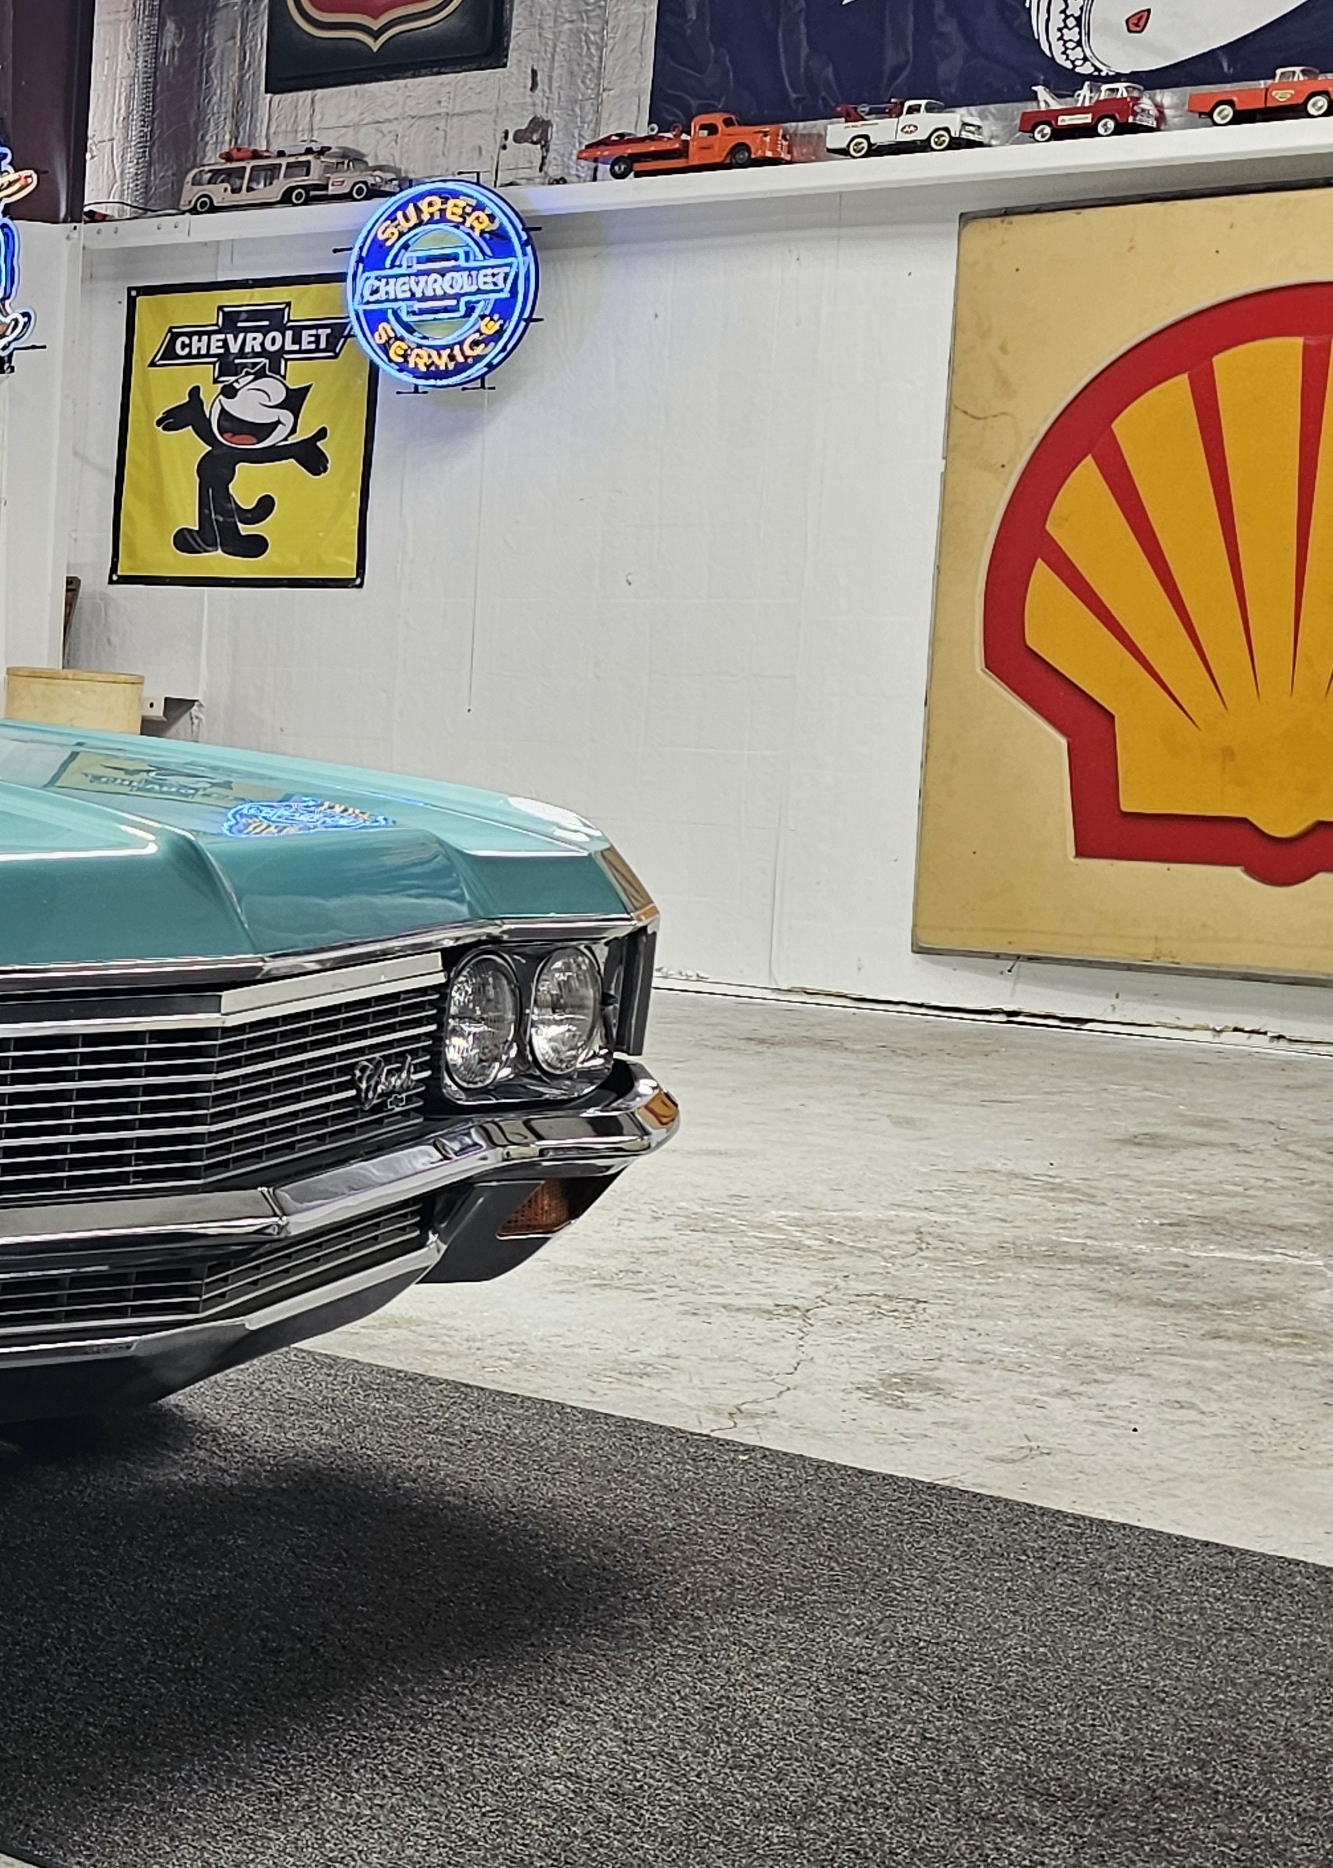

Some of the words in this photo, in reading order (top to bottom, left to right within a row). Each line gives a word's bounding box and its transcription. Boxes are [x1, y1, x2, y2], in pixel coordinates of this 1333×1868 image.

[376, 194, 501, 247] SUPER
[362, 266, 510, 302] CHEVROLET
[175, 328, 331, 357] CHEVROLET
[374, 314, 506, 373] SERVICE
